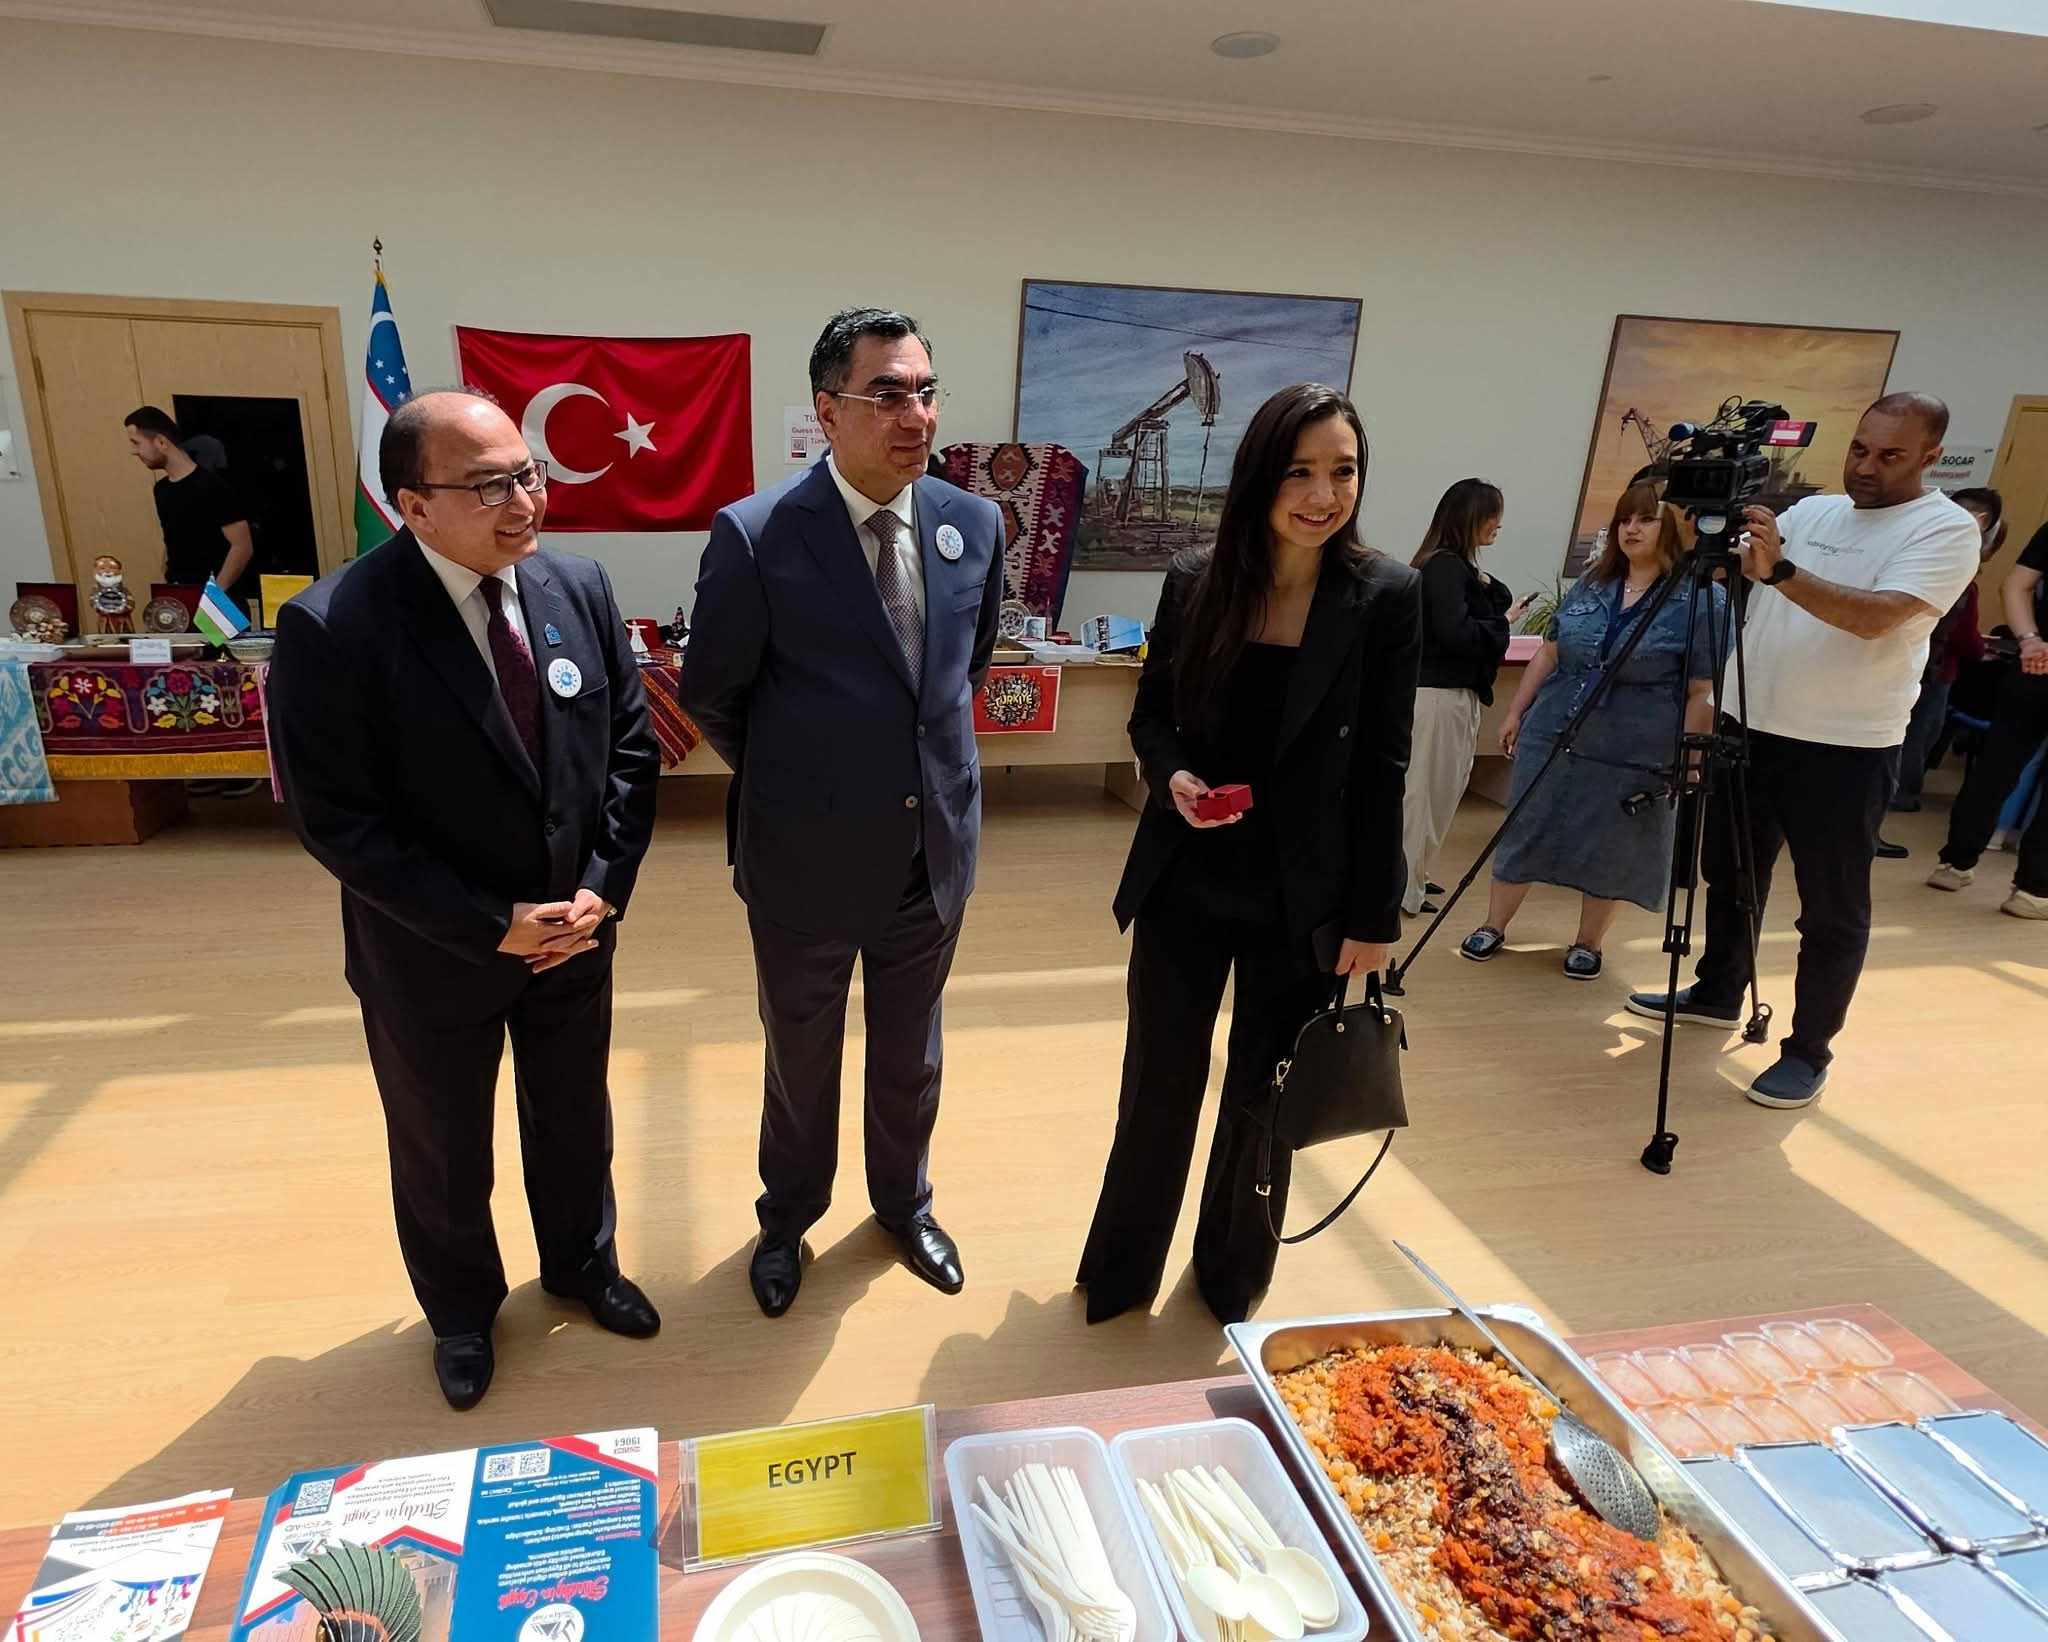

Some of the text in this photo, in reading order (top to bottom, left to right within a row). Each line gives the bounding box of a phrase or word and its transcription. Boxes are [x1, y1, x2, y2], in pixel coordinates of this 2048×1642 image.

[1941, 456, 1975, 465] SOCAR
[768, 1451, 857, 1488] EGYPT
[342, 1507, 381, 1526] Egypt
[396, 1499, 450, 1520] Study
